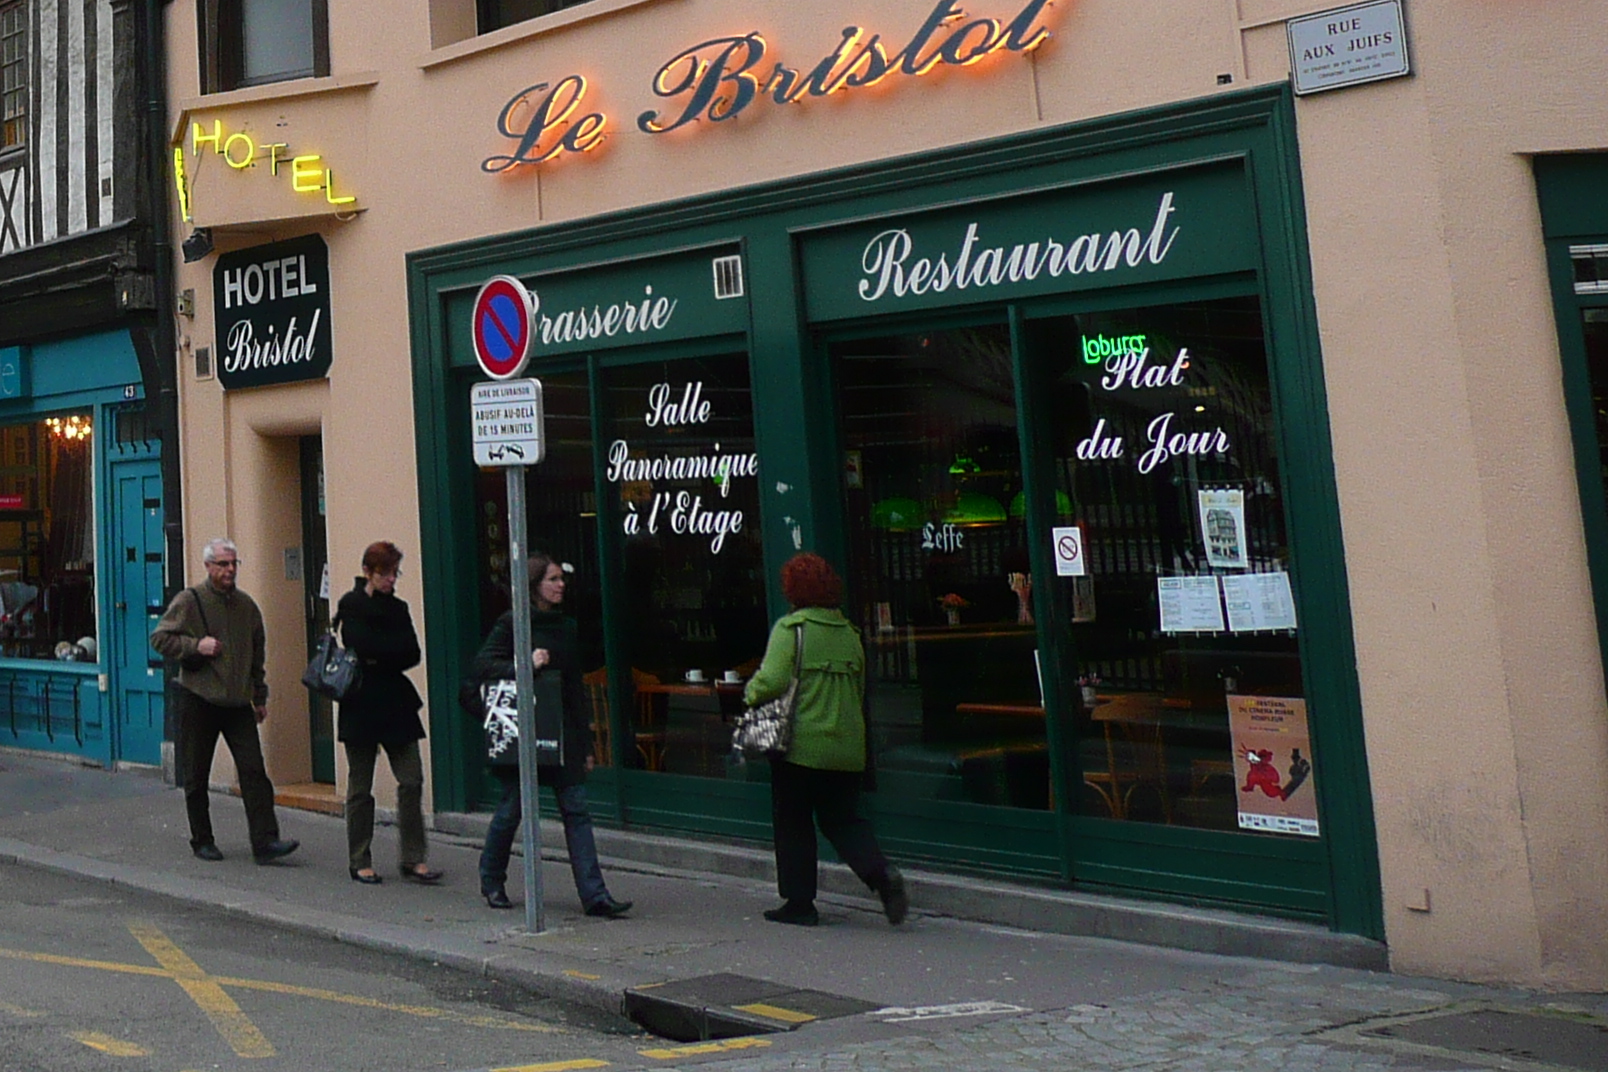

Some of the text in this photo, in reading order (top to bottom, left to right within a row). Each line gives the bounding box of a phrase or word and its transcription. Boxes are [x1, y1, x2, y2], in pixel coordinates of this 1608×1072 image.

[1303, 31, 1392, 61] AUX JUIFS
[1327, 18, 1361, 35] RUE
[481, 74, 607, 172] Le
[192, 119, 357, 204] HOTEL
[858, 192, 1180, 301] Restaurant
[224, 254, 317, 309] HOTEL
[224, 308, 321, 372] Bristol
[528, 284, 678, 344] rasserie
[1101, 347, 1189, 390] Plat
[476, 409, 500, 420] ABUSIF
[478, 423, 533, 436] DE 15 MINUTES
[646, 381, 711, 427] Salle
[607, 439, 758, 497] Panoramique
[1076, 413, 1230, 474] du Jour
[624, 490, 743, 554] à l'Etage
[921, 522, 964, 552] Leffe
